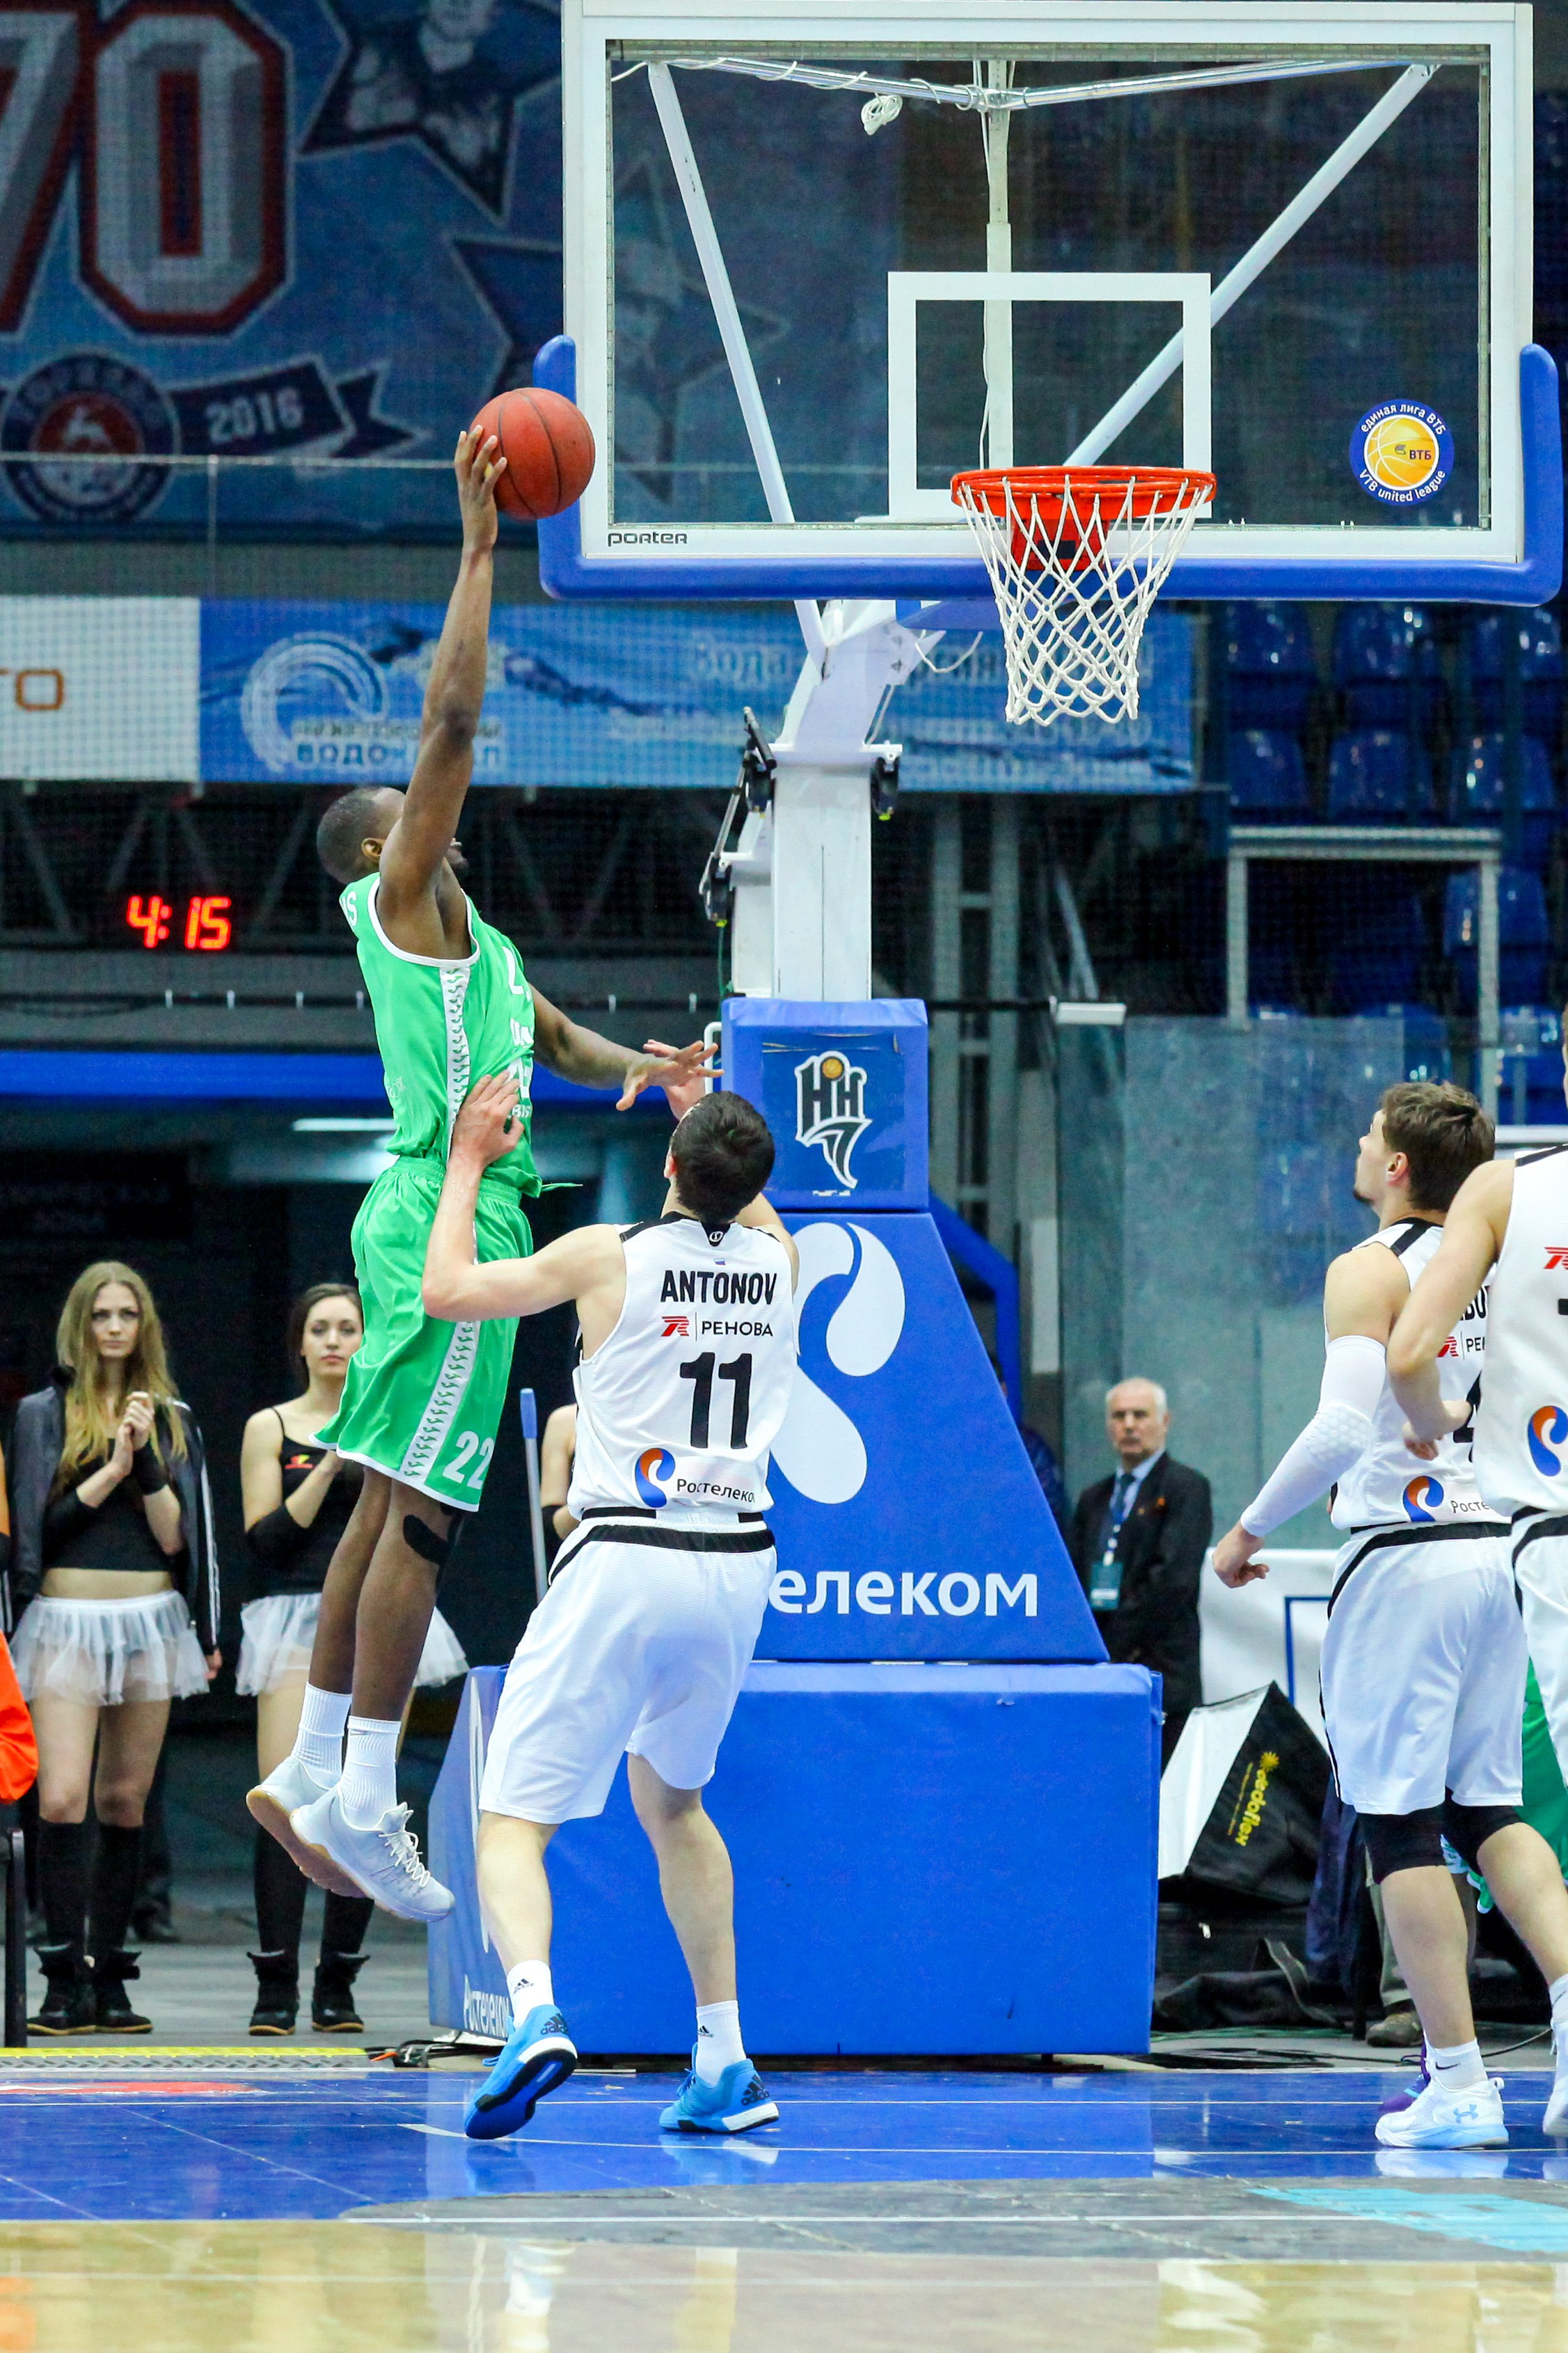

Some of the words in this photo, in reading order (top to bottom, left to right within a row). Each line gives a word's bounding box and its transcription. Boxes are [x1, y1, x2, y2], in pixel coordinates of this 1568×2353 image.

[207, 386, 304, 443] 2016
[1361, 404, 1397, 432] единая
[1400, 404, 1426, 418] лига
[1427, 413, 1447, 435] ВТБ
[1409, 450, 1432, 460] ВТБ
[1359, 469, 1379, 491] VTB
[1378, 489, 1413, 502] united
[1415, 471, 1446, 499] league
[127, 895, 232, 950] 4:15
[660, 1270, 777, 1305] ANTONOV
[702, 1321, 774, 1337] РЕНОВА
[679, 1351, 752, 1449] 11
[442, 1430, 495, 1490] 22
